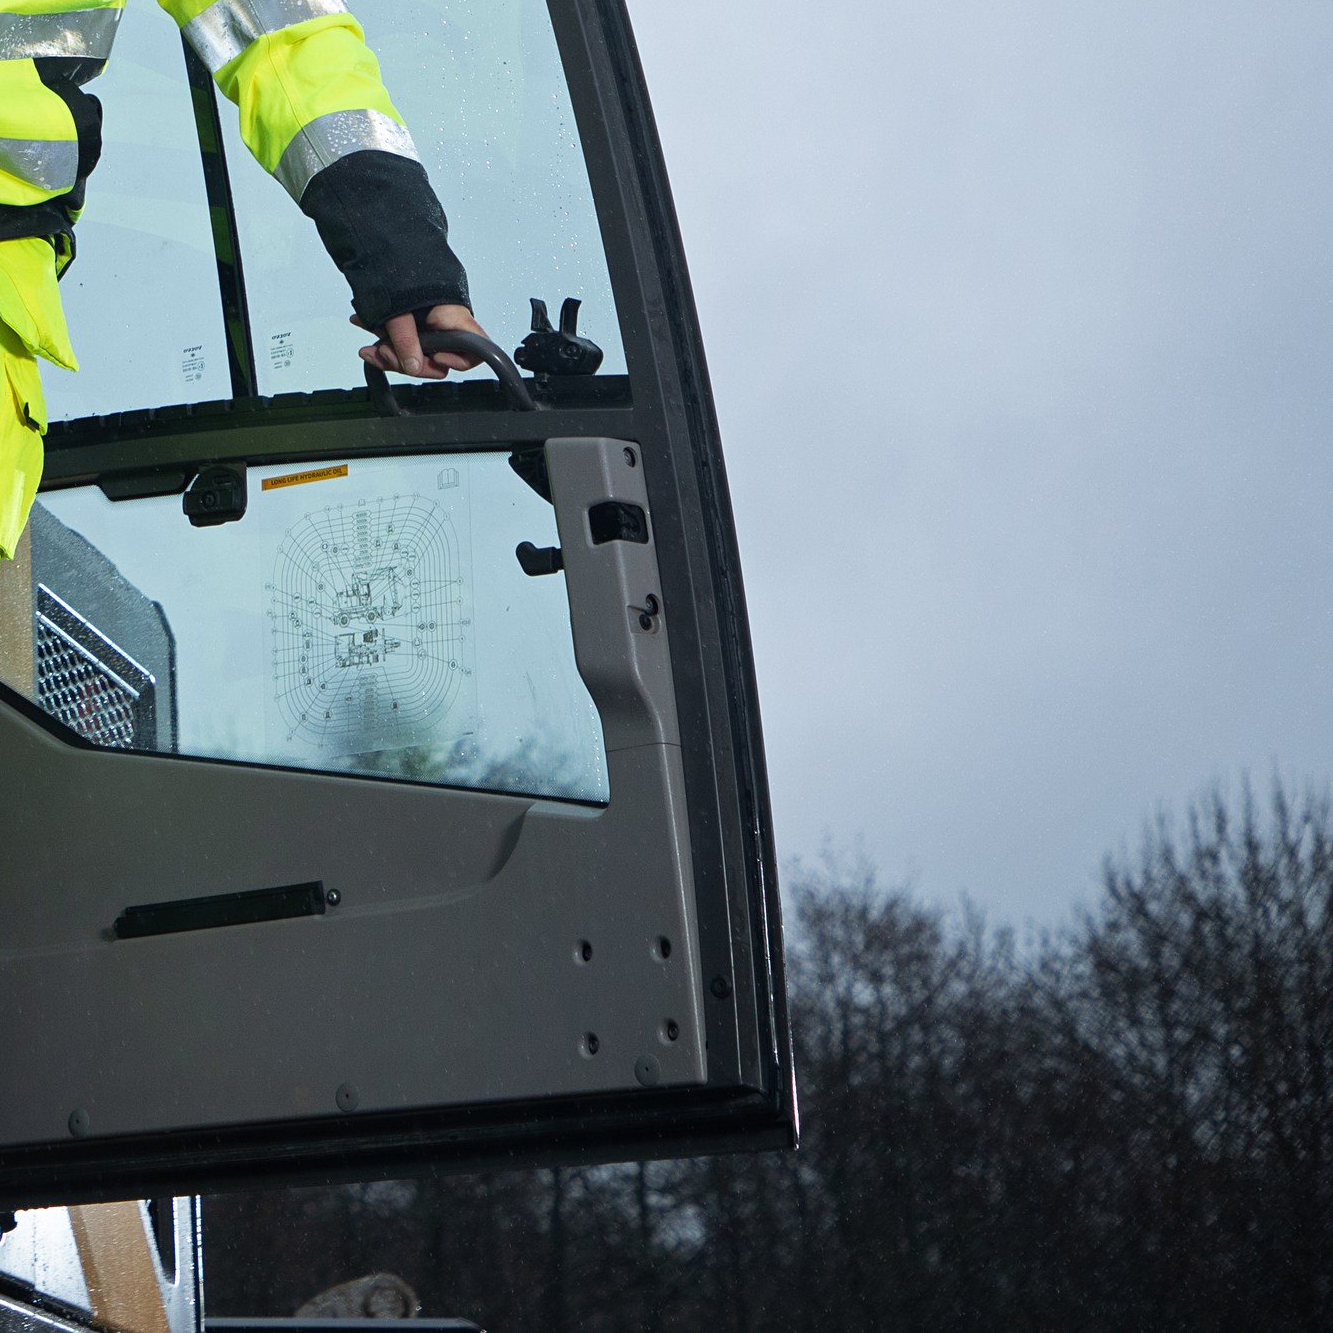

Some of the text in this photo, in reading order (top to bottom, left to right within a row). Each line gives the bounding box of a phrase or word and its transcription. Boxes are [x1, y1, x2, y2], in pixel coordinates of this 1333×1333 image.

[271, 478, 286, 486] LONG
[287, 475, 299, 483] LIFE
[300, 469, 332, 481] HYDRAULIC
